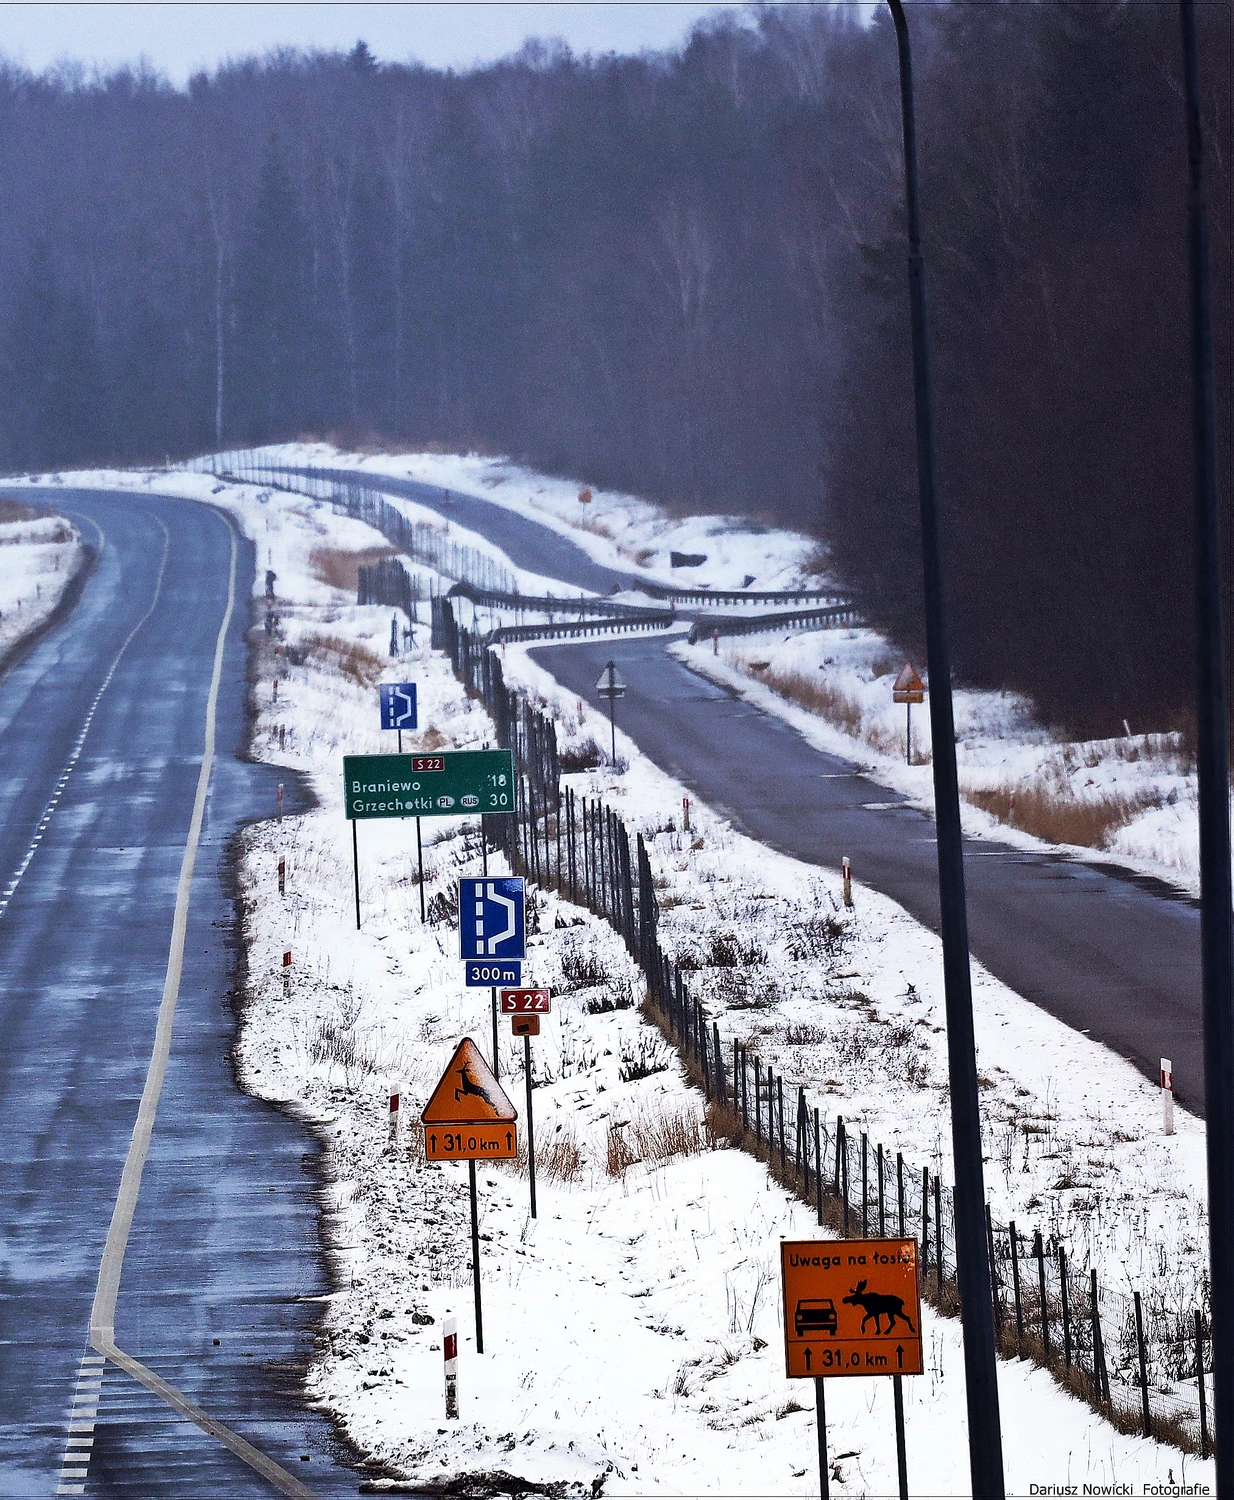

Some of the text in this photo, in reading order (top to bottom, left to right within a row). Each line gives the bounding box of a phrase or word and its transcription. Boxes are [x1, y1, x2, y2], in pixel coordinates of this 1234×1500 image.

[417, 757, 440, 770] S 22
[352, 779, 421, 793] Braniewo
[352, 793, 507, 812] Grzechotki PL RUS 30
[471, 967, 515, 981] 300 m
[507, 994, 544, 1010] S 22
[443, 1133, 500, 1153] 31,0 km
[789, 1253, 841, 1270] Uwaga
[847, 1255, 866, 1265] na
[822, 1348, 888, 1369] 31,0 km
